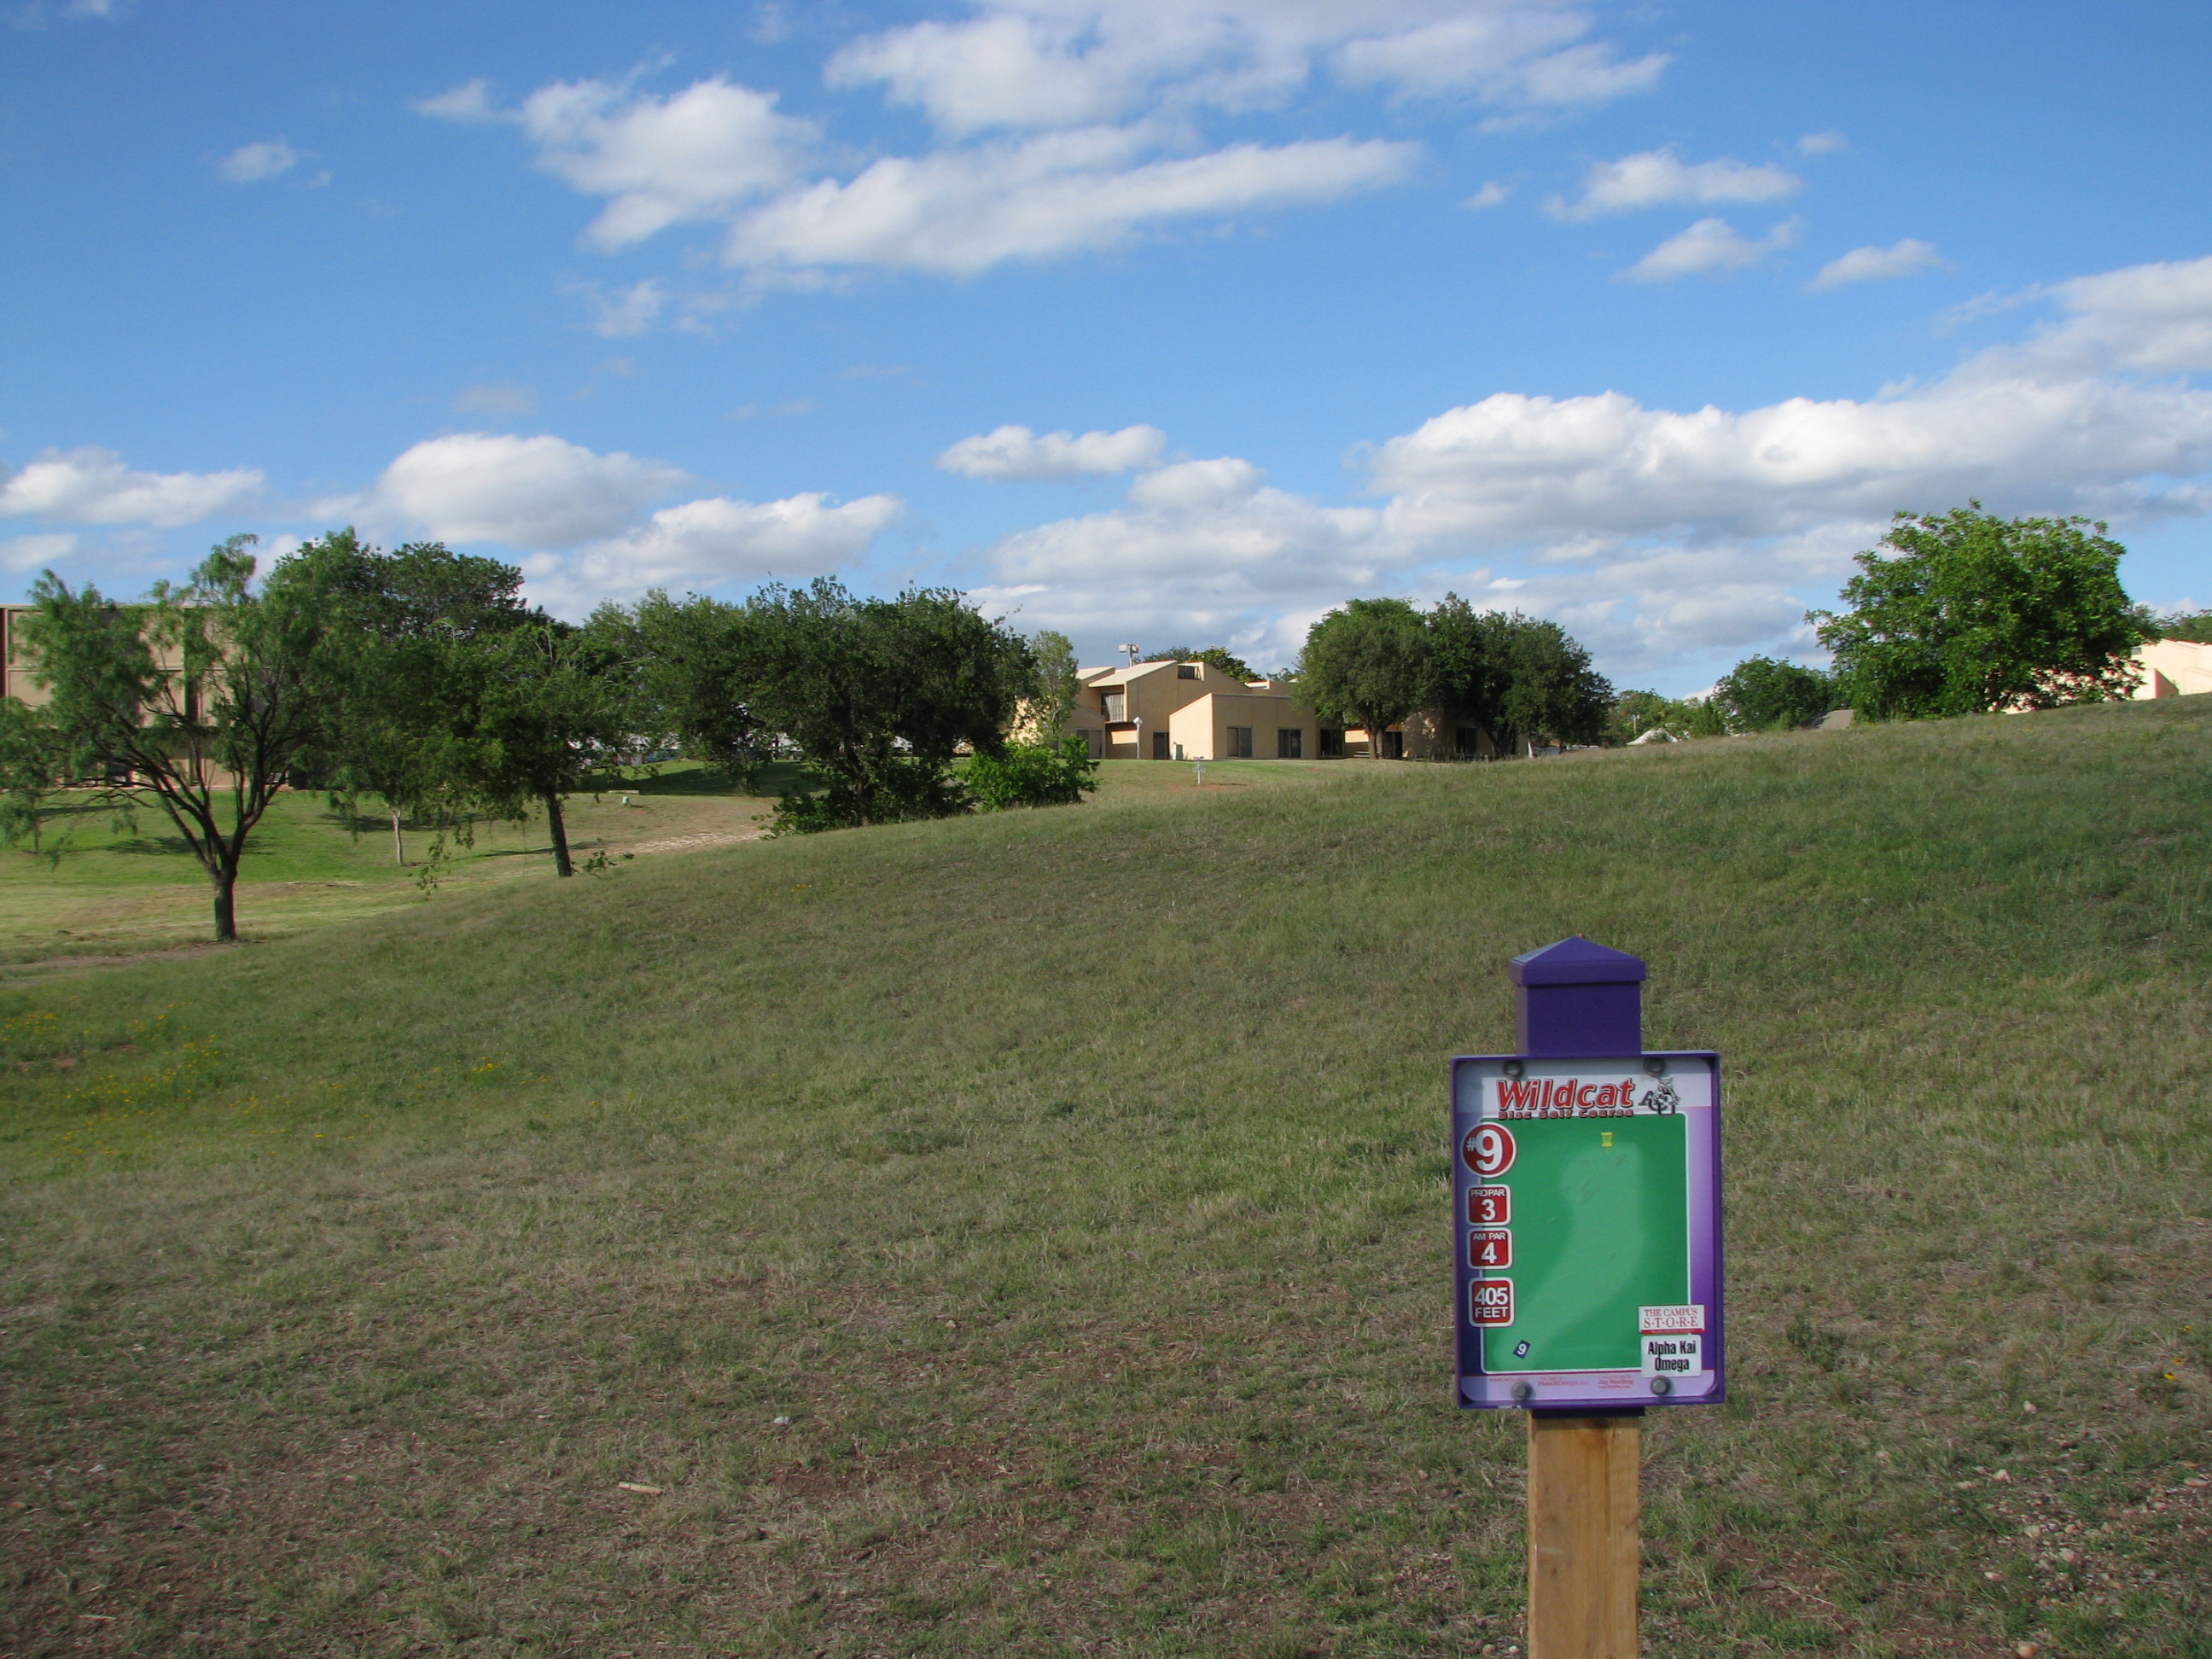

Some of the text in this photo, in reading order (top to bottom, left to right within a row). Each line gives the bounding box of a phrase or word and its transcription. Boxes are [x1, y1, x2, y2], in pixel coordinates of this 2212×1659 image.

[1496, 1078, 1635, 1110] Wildcat
[1498, 1109, 1634, 1121] Disc Golf Course
[1466, 1129, 1503, 1172] #9
[1470, 1188, 1505, 1197] PRO PAR
[1481, 1198, 1496, 1221] 3
[1473, 1232, 1487, 1241] AM
[1481, 1242, 1497, 1264] 4
[1475, 1287, 1509, 1306] 405
[1475, 1307, 1509, 1318] FEET
[1644, 1307, 1698, 1317] THE CAMPUS
[1516, 1343, 1528, 1355] 9
[1648, 1340, 1697, 1358] Alpha Kai
[1655, 1356, 1691, 1372] Omega
